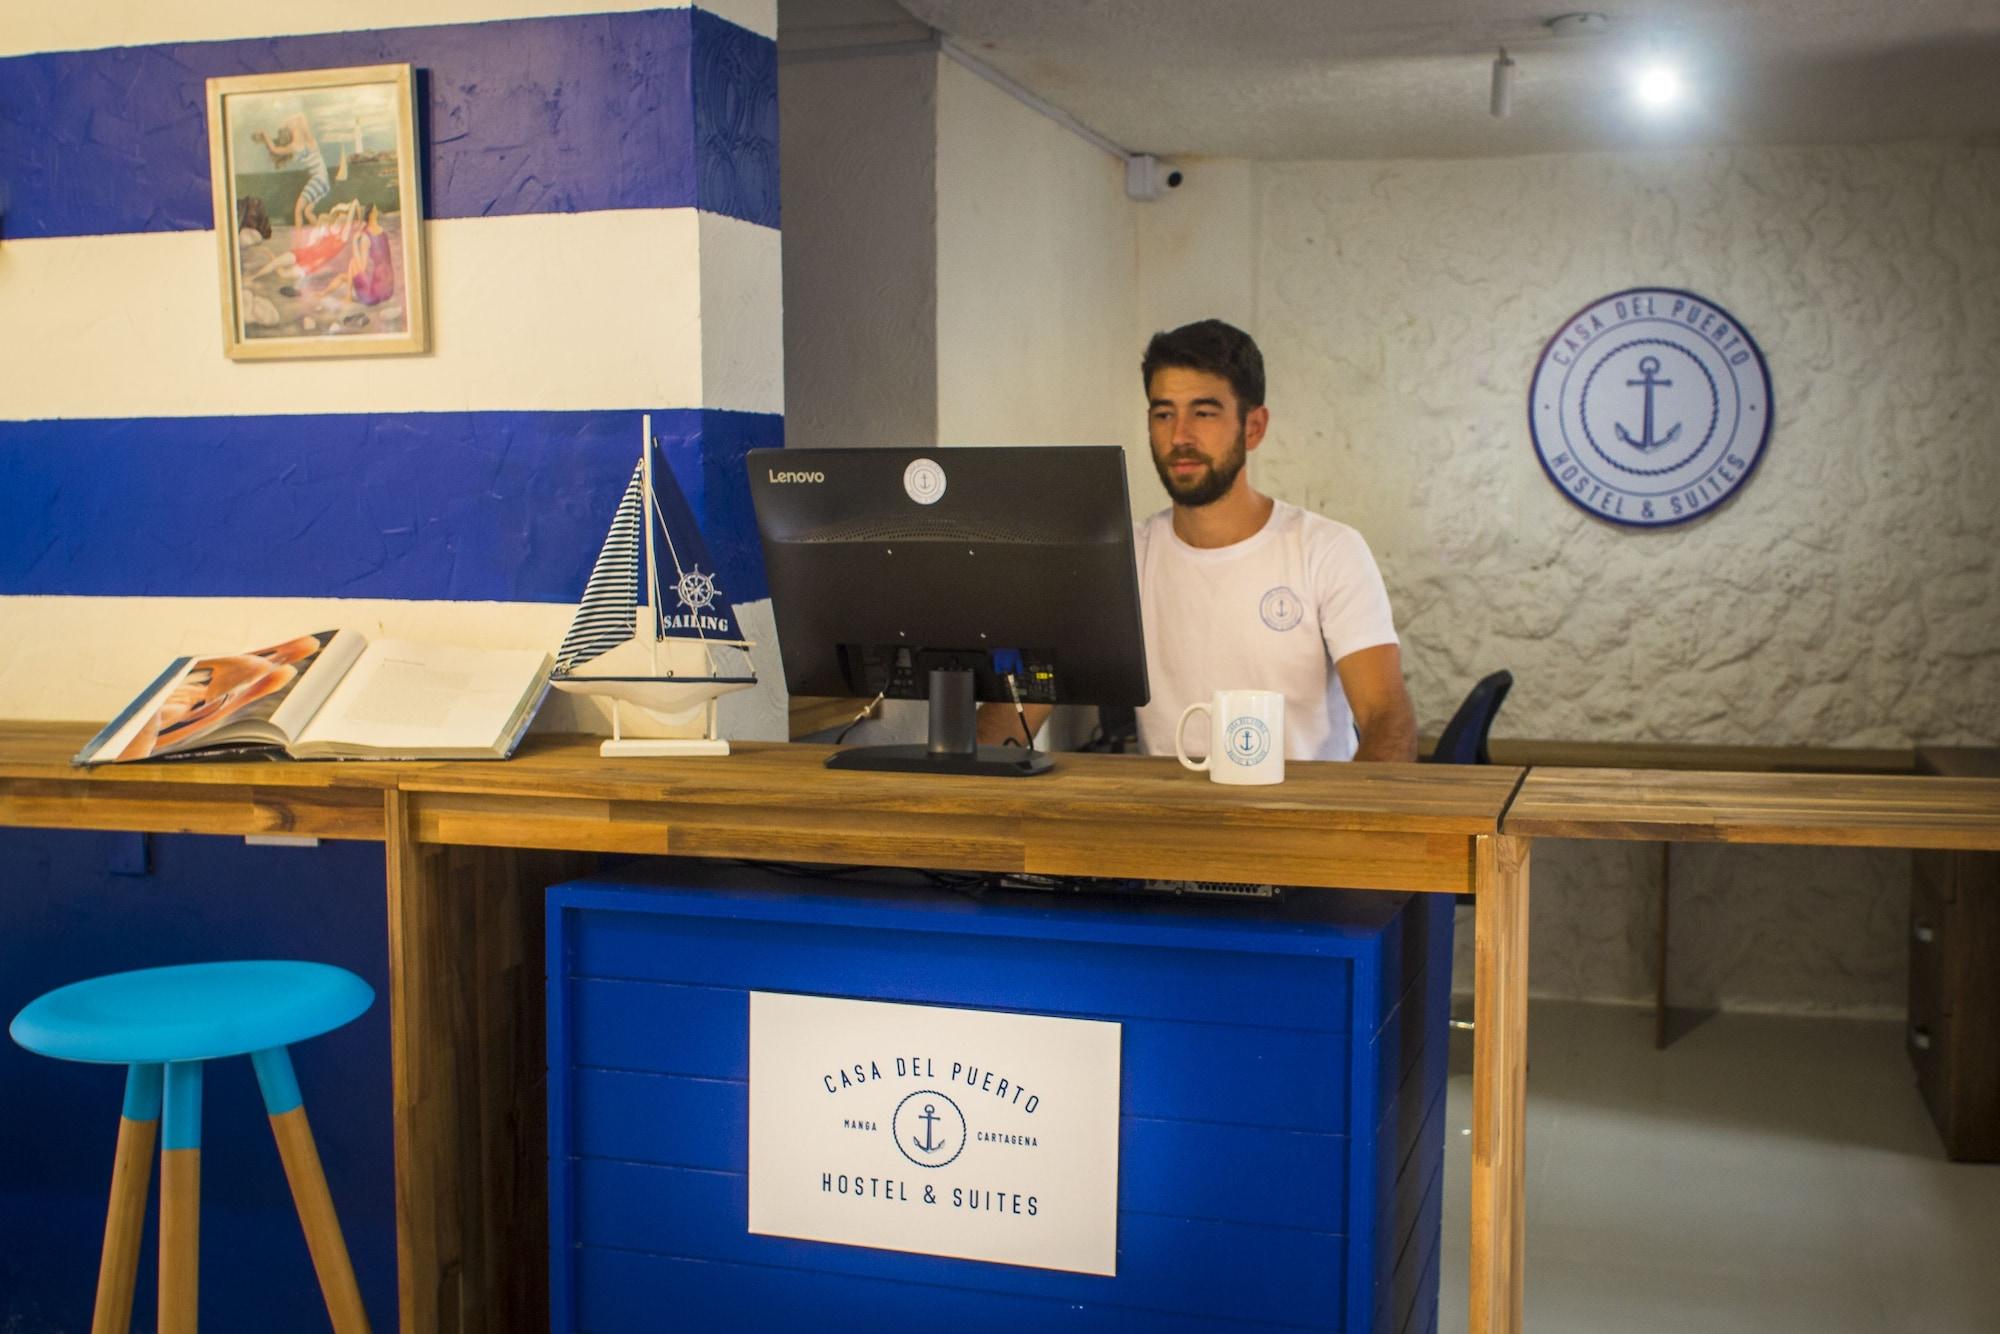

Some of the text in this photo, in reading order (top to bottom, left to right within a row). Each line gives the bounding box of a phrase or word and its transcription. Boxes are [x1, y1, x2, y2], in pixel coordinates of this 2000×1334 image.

[1553, 297, 1750, 366] CASA DEL PUERTO
[769, 469, 824, 483] Lenovo
[1552, 452, 1746, 518] HOSTEL & SUITES
[664, 614, 728, 632] SAILING
[824, 1057, 1040, 1114] CASA DEL PUERTO
[844, 1119, 878, 1132] MANGA
[977, 1131, 1038, 1147] CARTAGENA
[822, 1172, 1038, 1217] HOSTEL & SUITES
